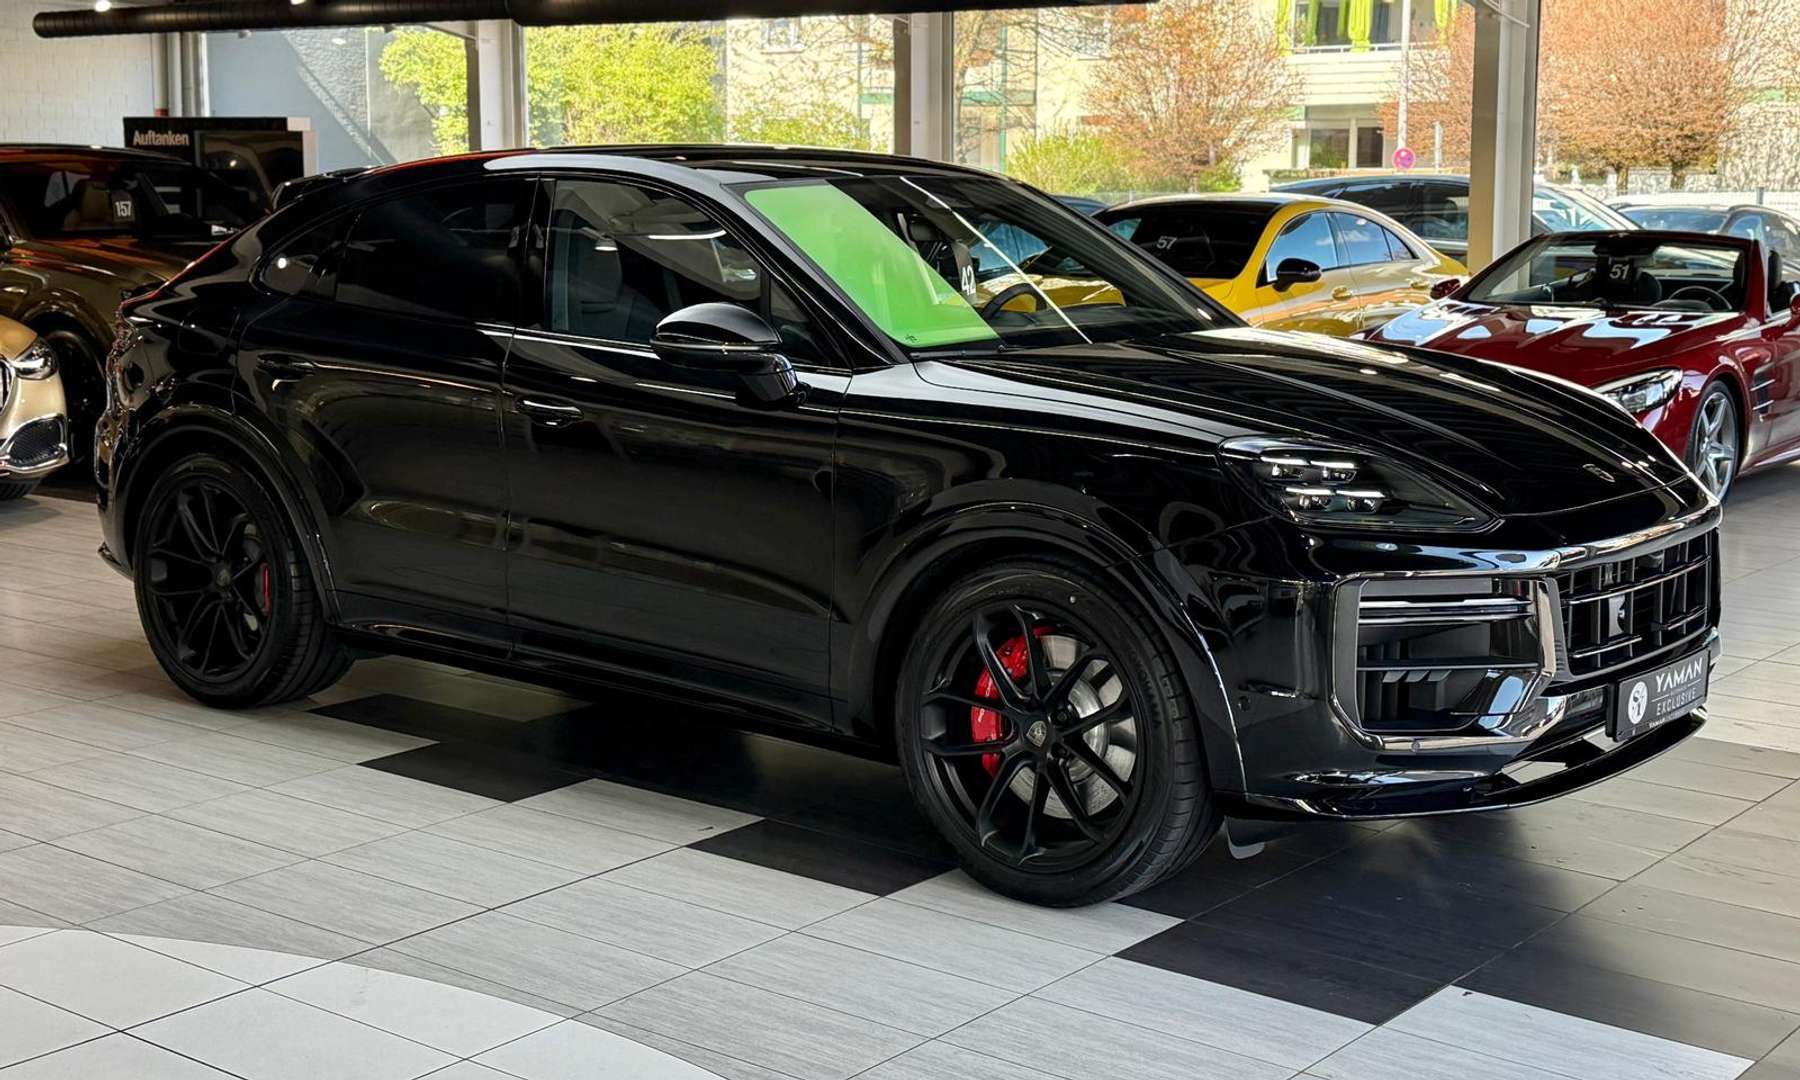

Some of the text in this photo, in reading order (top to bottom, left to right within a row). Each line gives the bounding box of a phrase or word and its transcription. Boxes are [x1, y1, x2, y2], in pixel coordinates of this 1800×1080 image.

[133, 130, 189, 146] Auftanken
[115, 200, 132, 216] 157
[1157, 236, 1176, 249] 57
[961, 264, 976, 296] 42
[1609, 264, 1630, 280] 51
[1656, 658, 1702, 692] YAMAN
[1656, 687, 1697, 716] EXCLUSIVE
